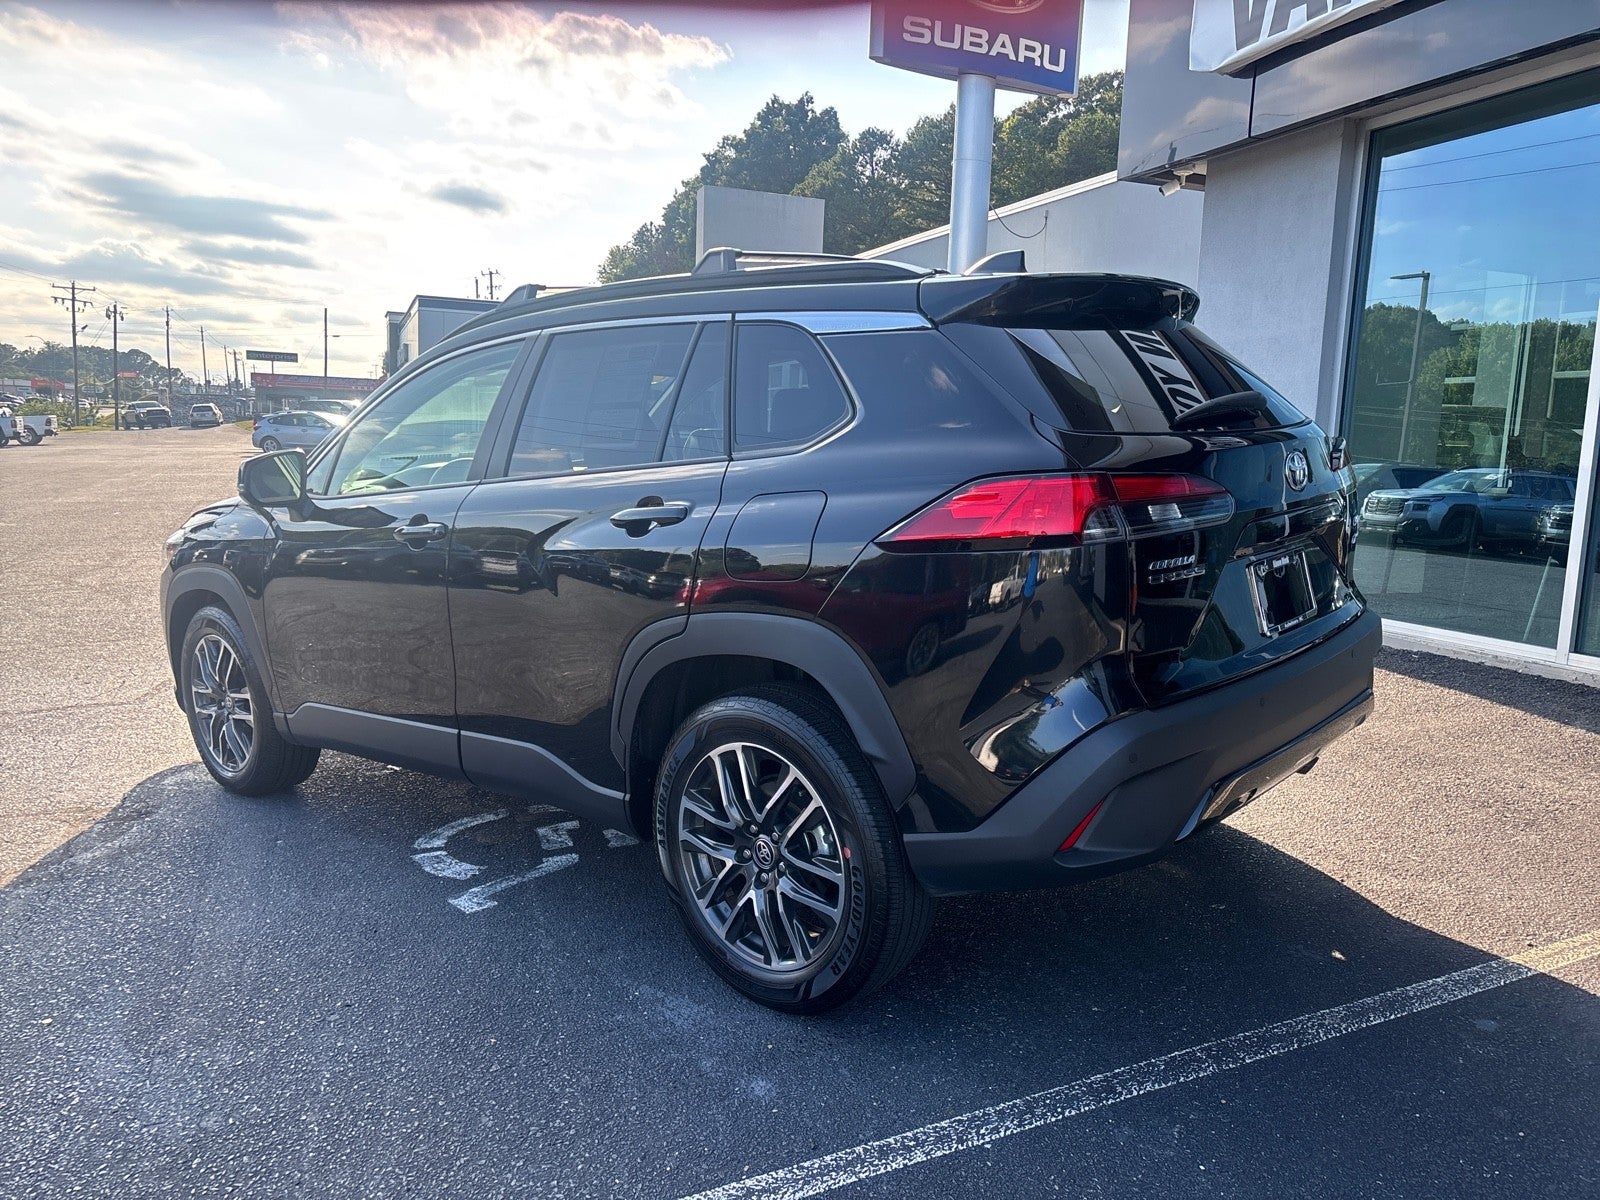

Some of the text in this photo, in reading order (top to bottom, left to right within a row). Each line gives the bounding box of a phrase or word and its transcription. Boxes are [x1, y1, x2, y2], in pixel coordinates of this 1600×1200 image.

[902, 15, 1067, 73] SUBARU
[657, 751, 680, 850] ASSURANCE
[830, 864, 864, 976] GOODYEAR
